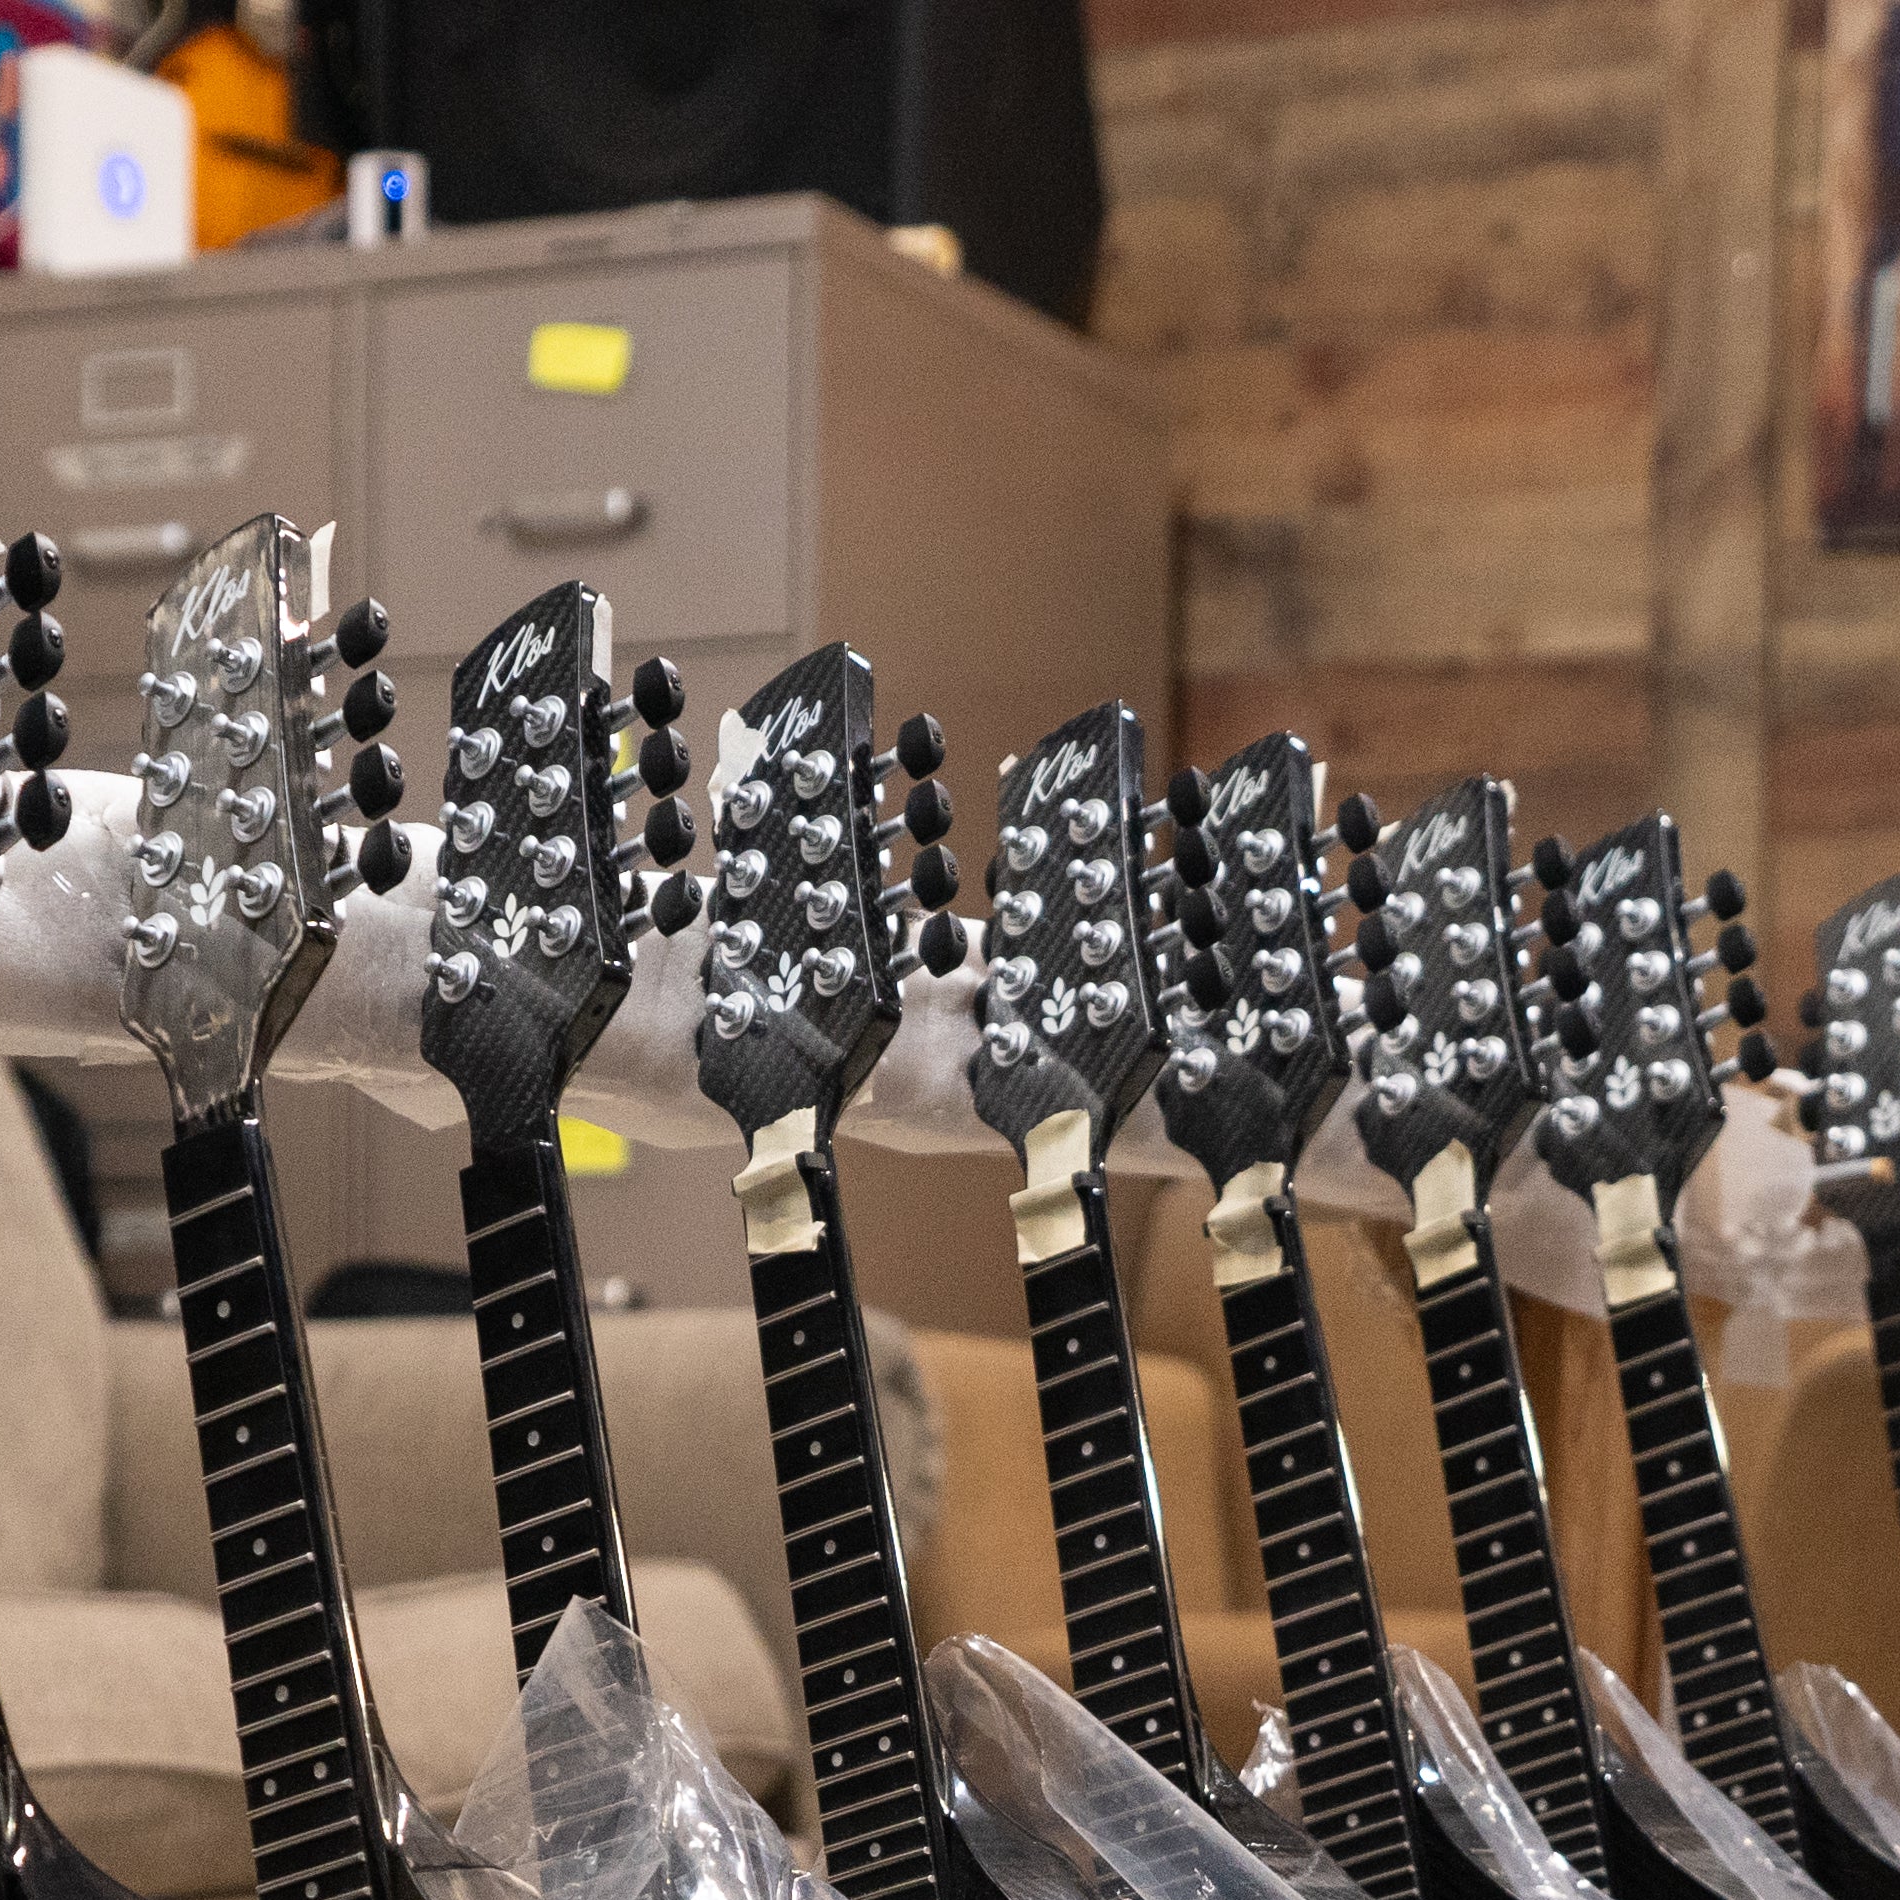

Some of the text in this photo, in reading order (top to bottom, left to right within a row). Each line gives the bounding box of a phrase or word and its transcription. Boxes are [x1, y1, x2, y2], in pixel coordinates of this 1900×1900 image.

[171, 565, 250, 657] Klos
[476, 622, 556, 709] Klos
[1021, 740, 1098, 816] Klos
